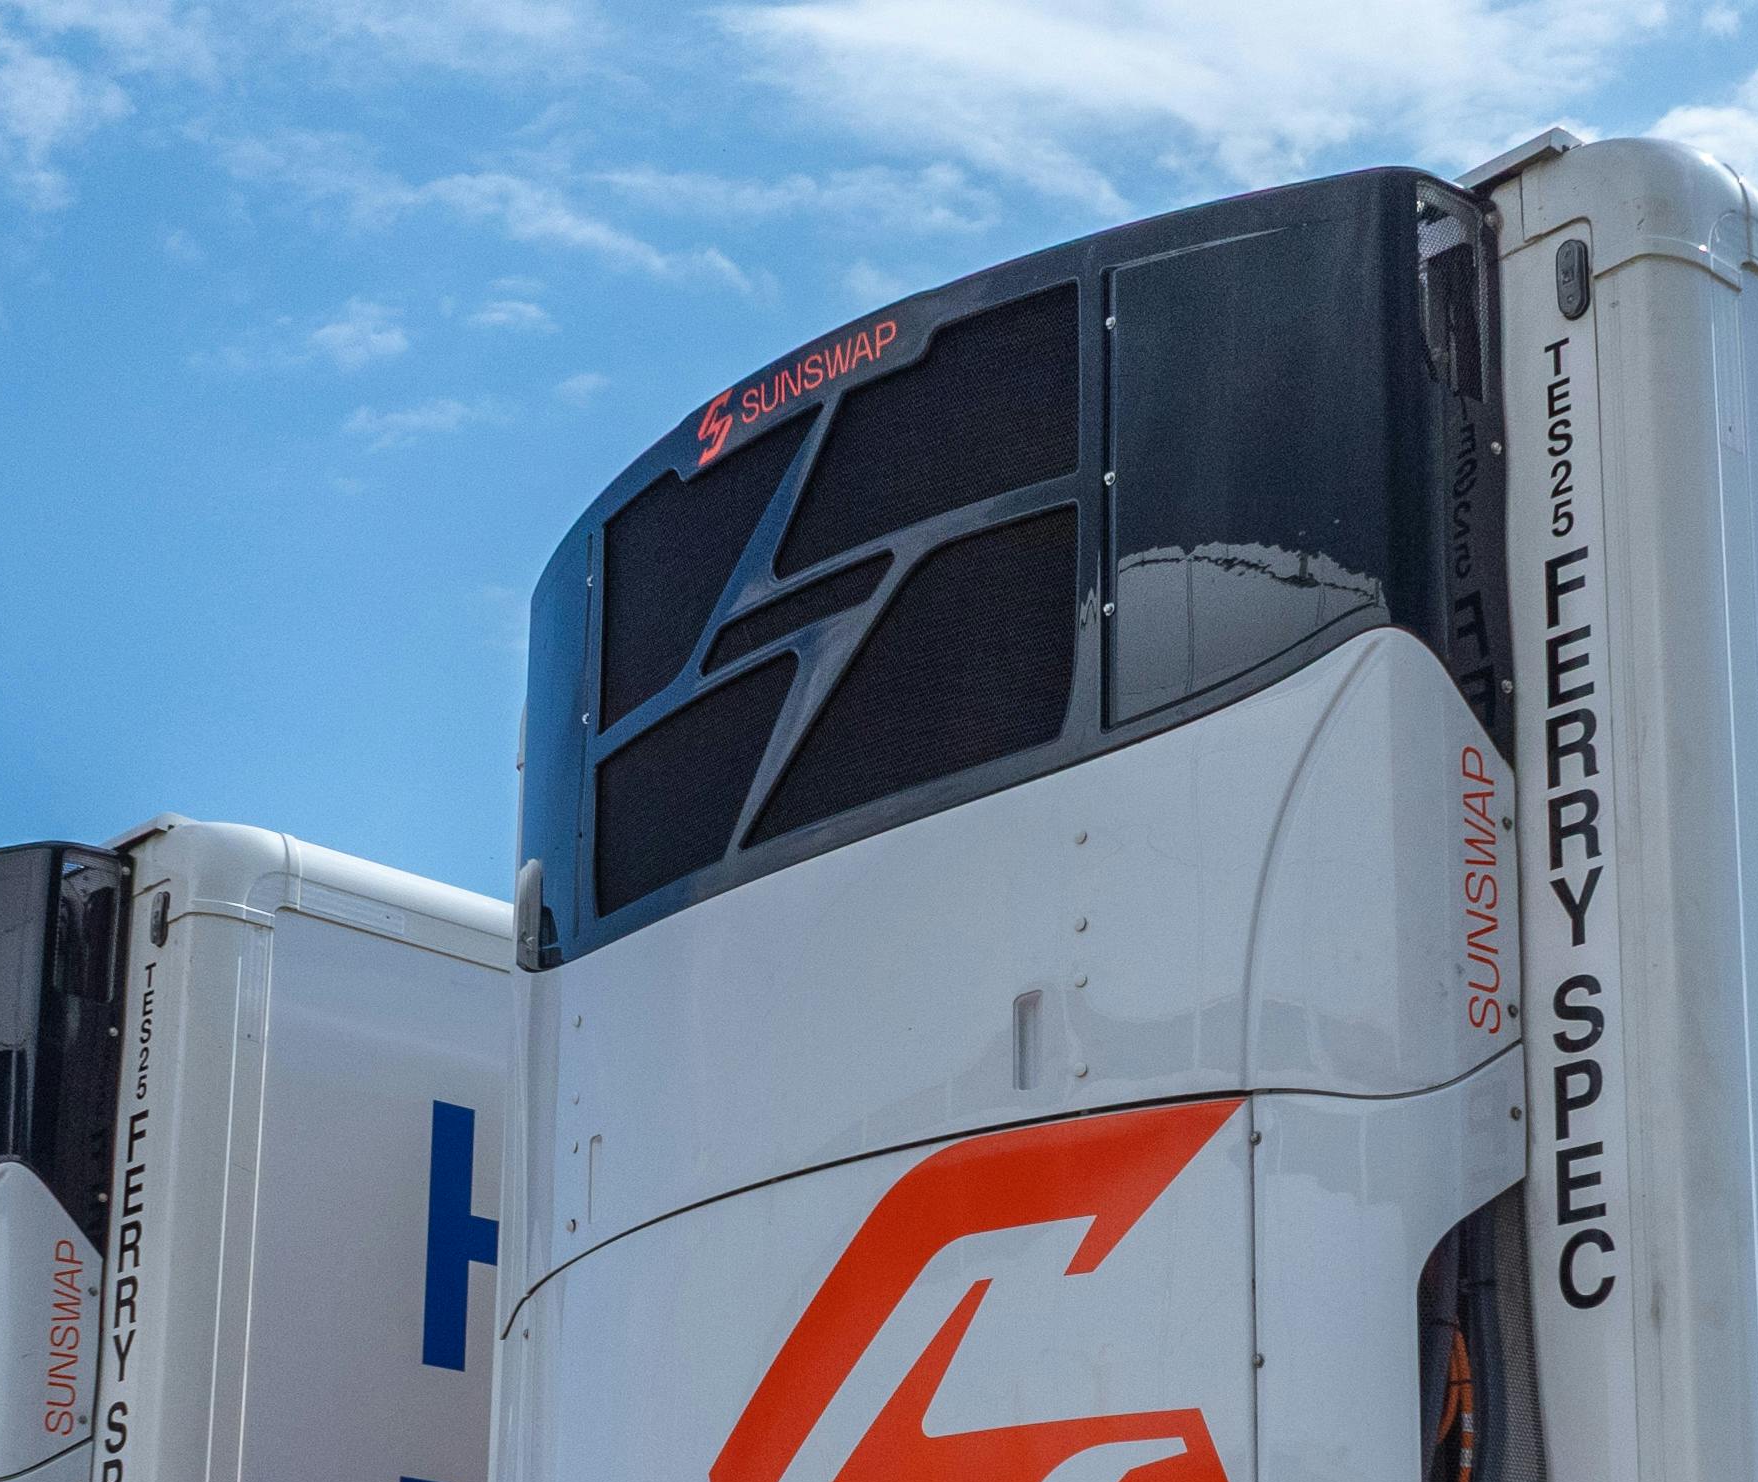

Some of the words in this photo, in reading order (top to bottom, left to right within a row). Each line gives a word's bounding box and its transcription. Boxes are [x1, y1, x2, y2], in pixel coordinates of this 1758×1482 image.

[741, 320, 898, 424] SUNSWAP
[1544, 337, 1575, 538] TES25
[1545, 545, 1604, 947] FERRY
[1462, 746, 1501, 1034] SUNSWAP
[136, 962, 157, 1101] TES25
[1553, 974, 1616, 1310] SPEC
[44, 1239, 84, 1436] SUNSWAP
[113, 1109, 149, 1382] FERRY
